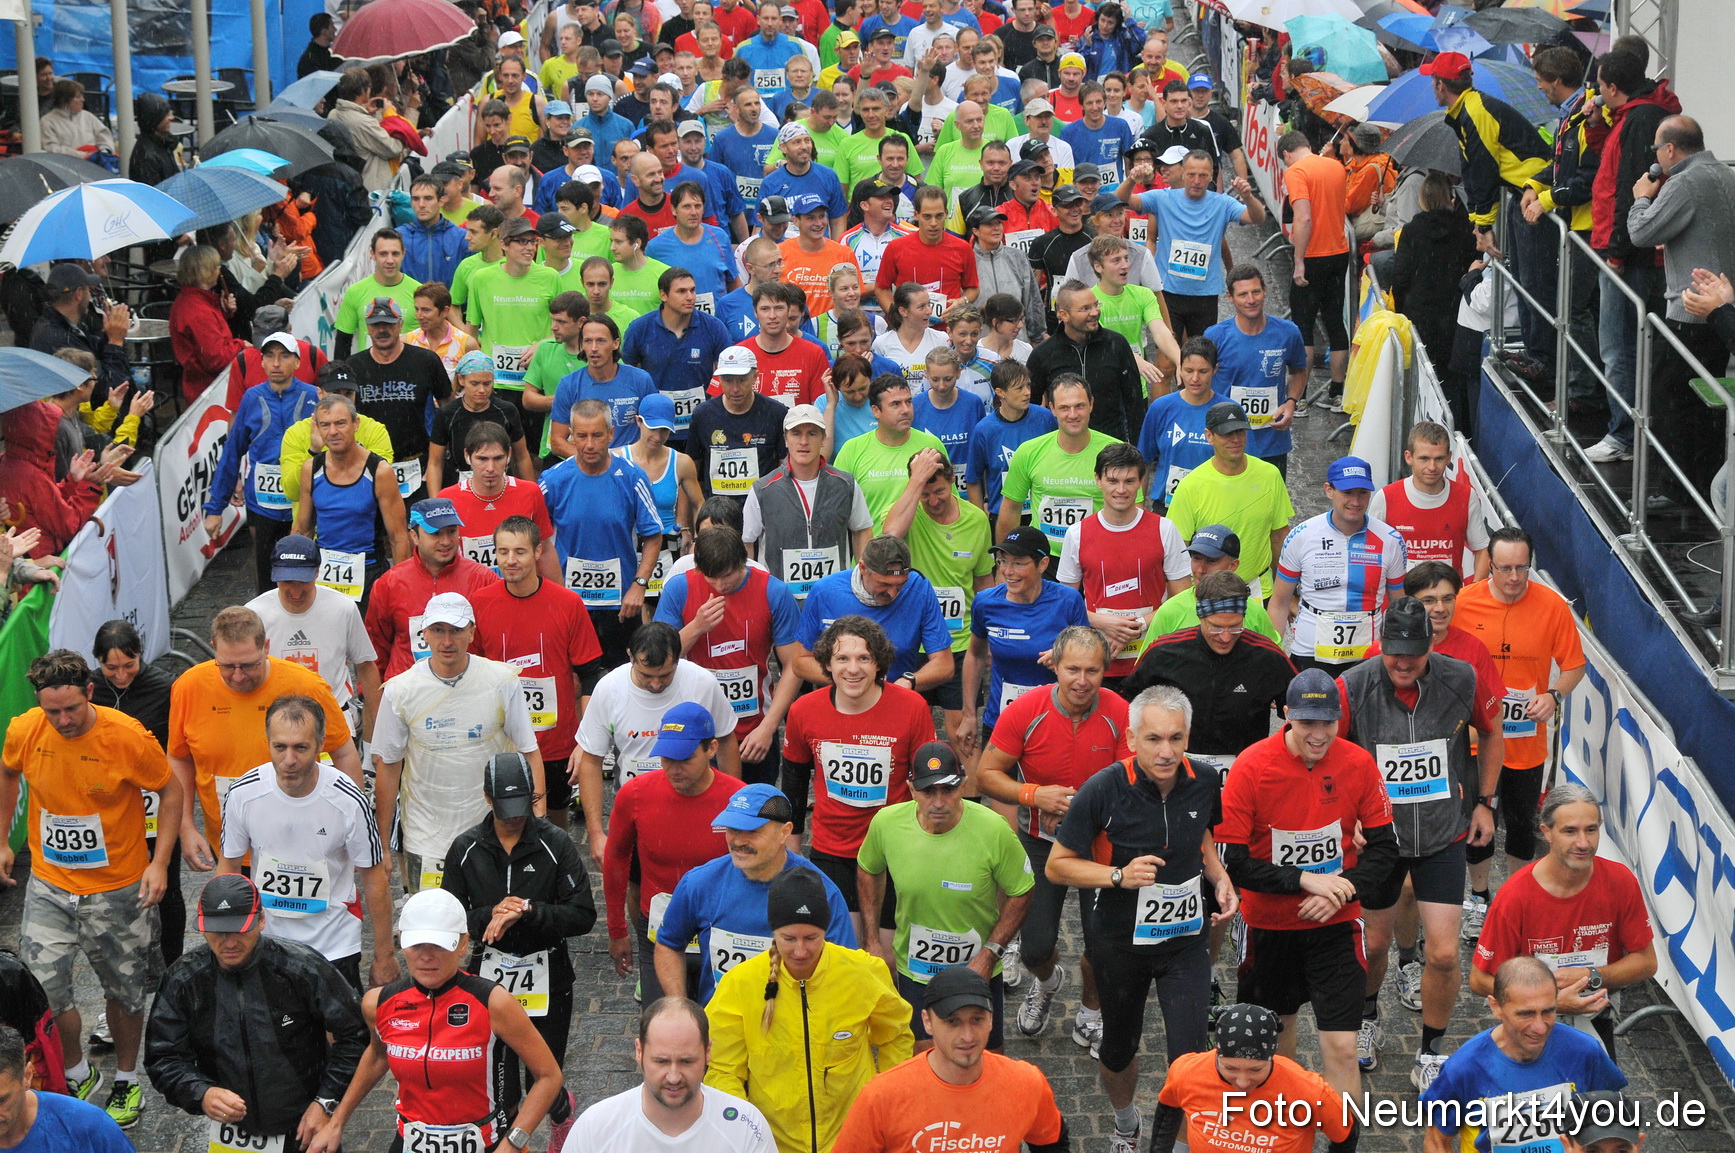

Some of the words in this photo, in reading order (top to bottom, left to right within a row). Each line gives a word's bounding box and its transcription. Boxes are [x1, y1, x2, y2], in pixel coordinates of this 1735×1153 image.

[757, 76, 782, 87] 2561
[1174, 249, 1207, 267] 2149
[941, 432, 968, 442] PLAST
[718, 460, 749, 479] 404
[720, 481, 748, 491] Gerhard
[1044, 507, 1088, 526] 3167
[323, 563, 353, 583] 214
[571, 571, 616, 588] 2232
[790, 560, 835, 581] 2047
[581, 590, 605, 600] Günter
[1114, 583, 1130, 592] DEHN
[1333, 625, 1357, 646] 37
[1333, 648, 1354, 658] Frank
[861, 735, 897, 743] NEUMARKTER
[828, 760, 883, 785] 2306
[1384, 755, 1442, 783] 2250
[841, 787, 868, 799] Martin
[1398, 783, 1431, 796] Helmut
[46, 826, 98, 850] 2939
[55, 852, 88, 863] Wobbel
[1280, 838, 1339, 866] 2269
[262, 870, 323, 897] 2317
[272, 898, 307, 911] Johann
[1144, 894, 1198, 923] 2249
[1150, 923, 1190, 938] Chrsitian
[916, 940, 975, 963] 2207
[494, 967, 534, 992] 274
[433, 1046, 482, 1060] EXPERTS
[410, 1127, 478, 1153] 2556
[930, 1133, 1006, 1153] Fischer
[1202, 1122, 1278, 1148] Fischer
